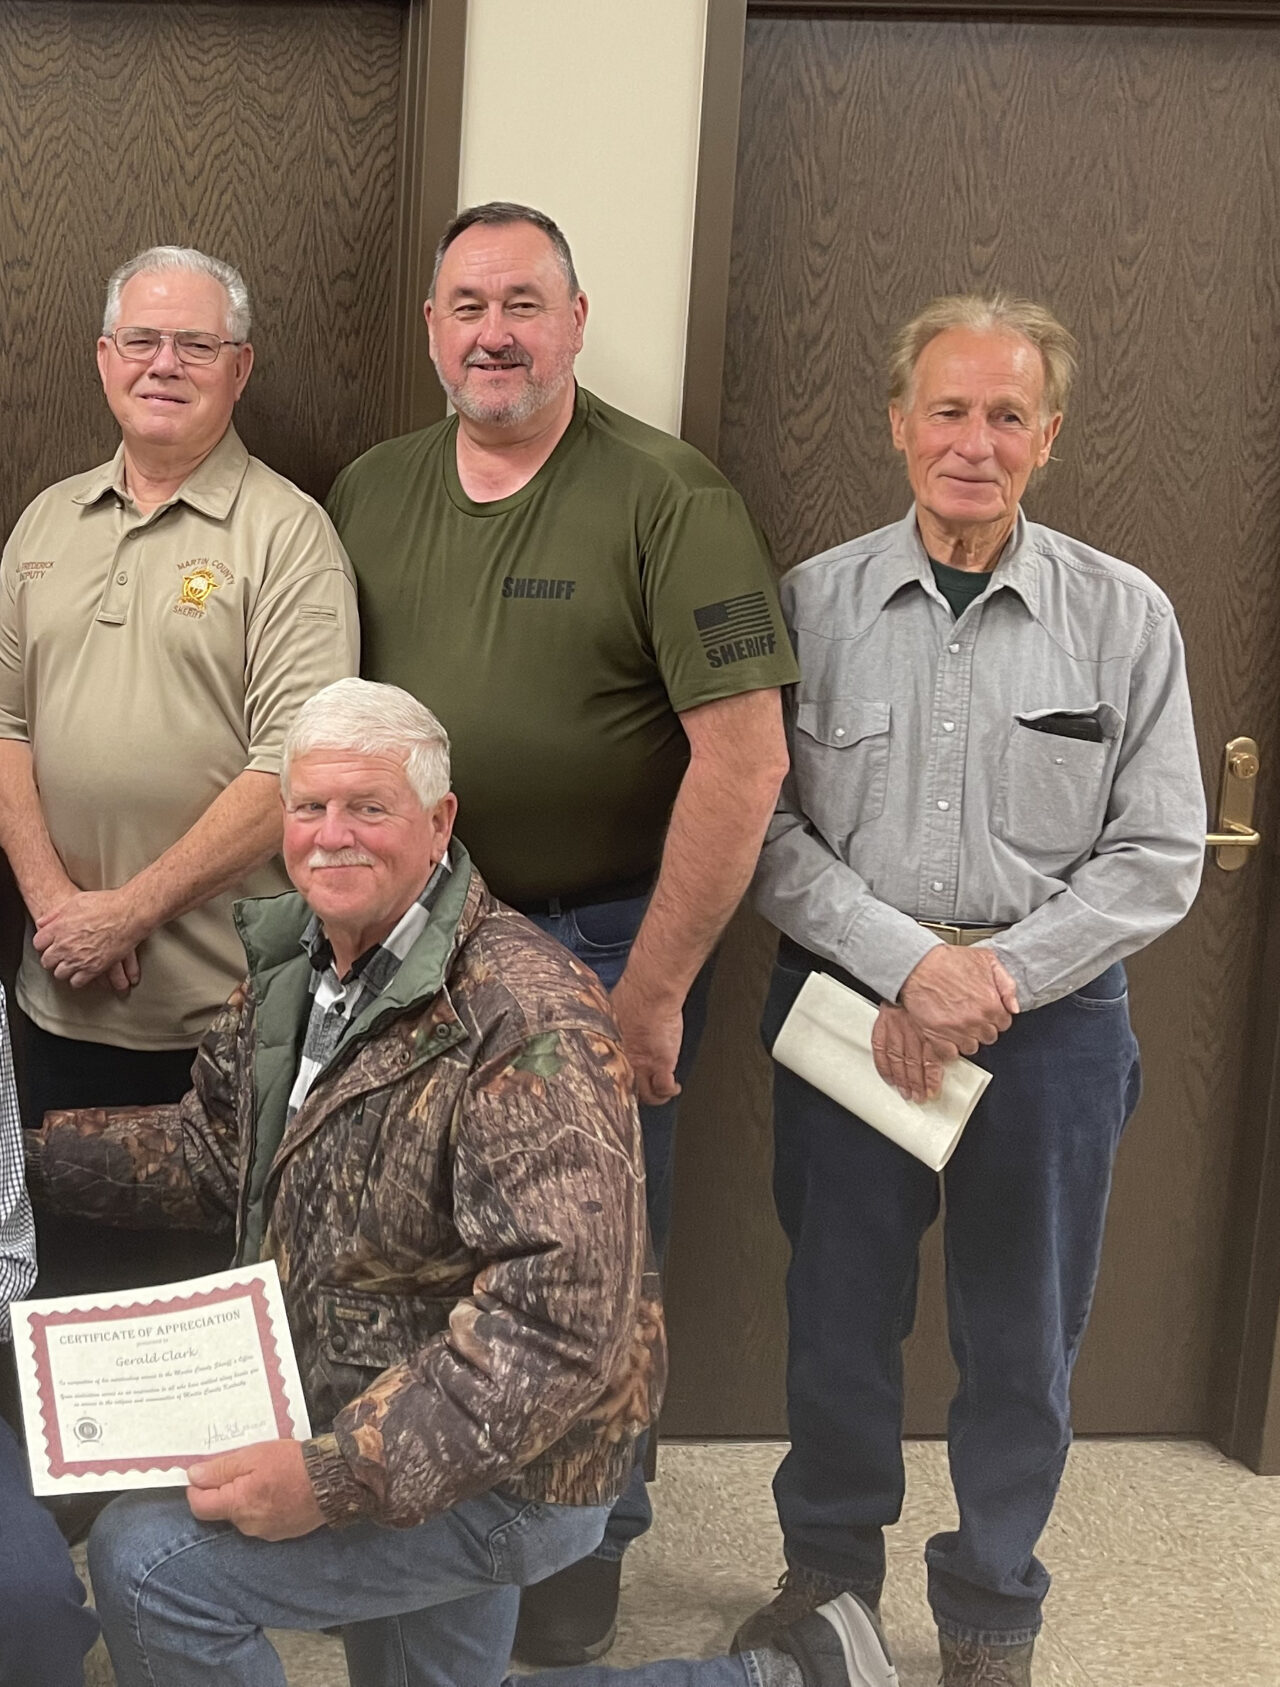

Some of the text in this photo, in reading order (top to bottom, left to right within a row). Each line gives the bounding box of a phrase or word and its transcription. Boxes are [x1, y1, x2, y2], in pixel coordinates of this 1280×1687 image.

[211, 559, 235, 585] COUNTY
[501, 576, 576, 600] SHERIFF
[173, 604, 205, 619] SHERIFF
[705, 632, 777, 669] SHERIFF
[59, 1309, 241, 1345] CERTIFICATE OF APPRECIATION
[115, 1347, 199, 1367] Gerald Clark
